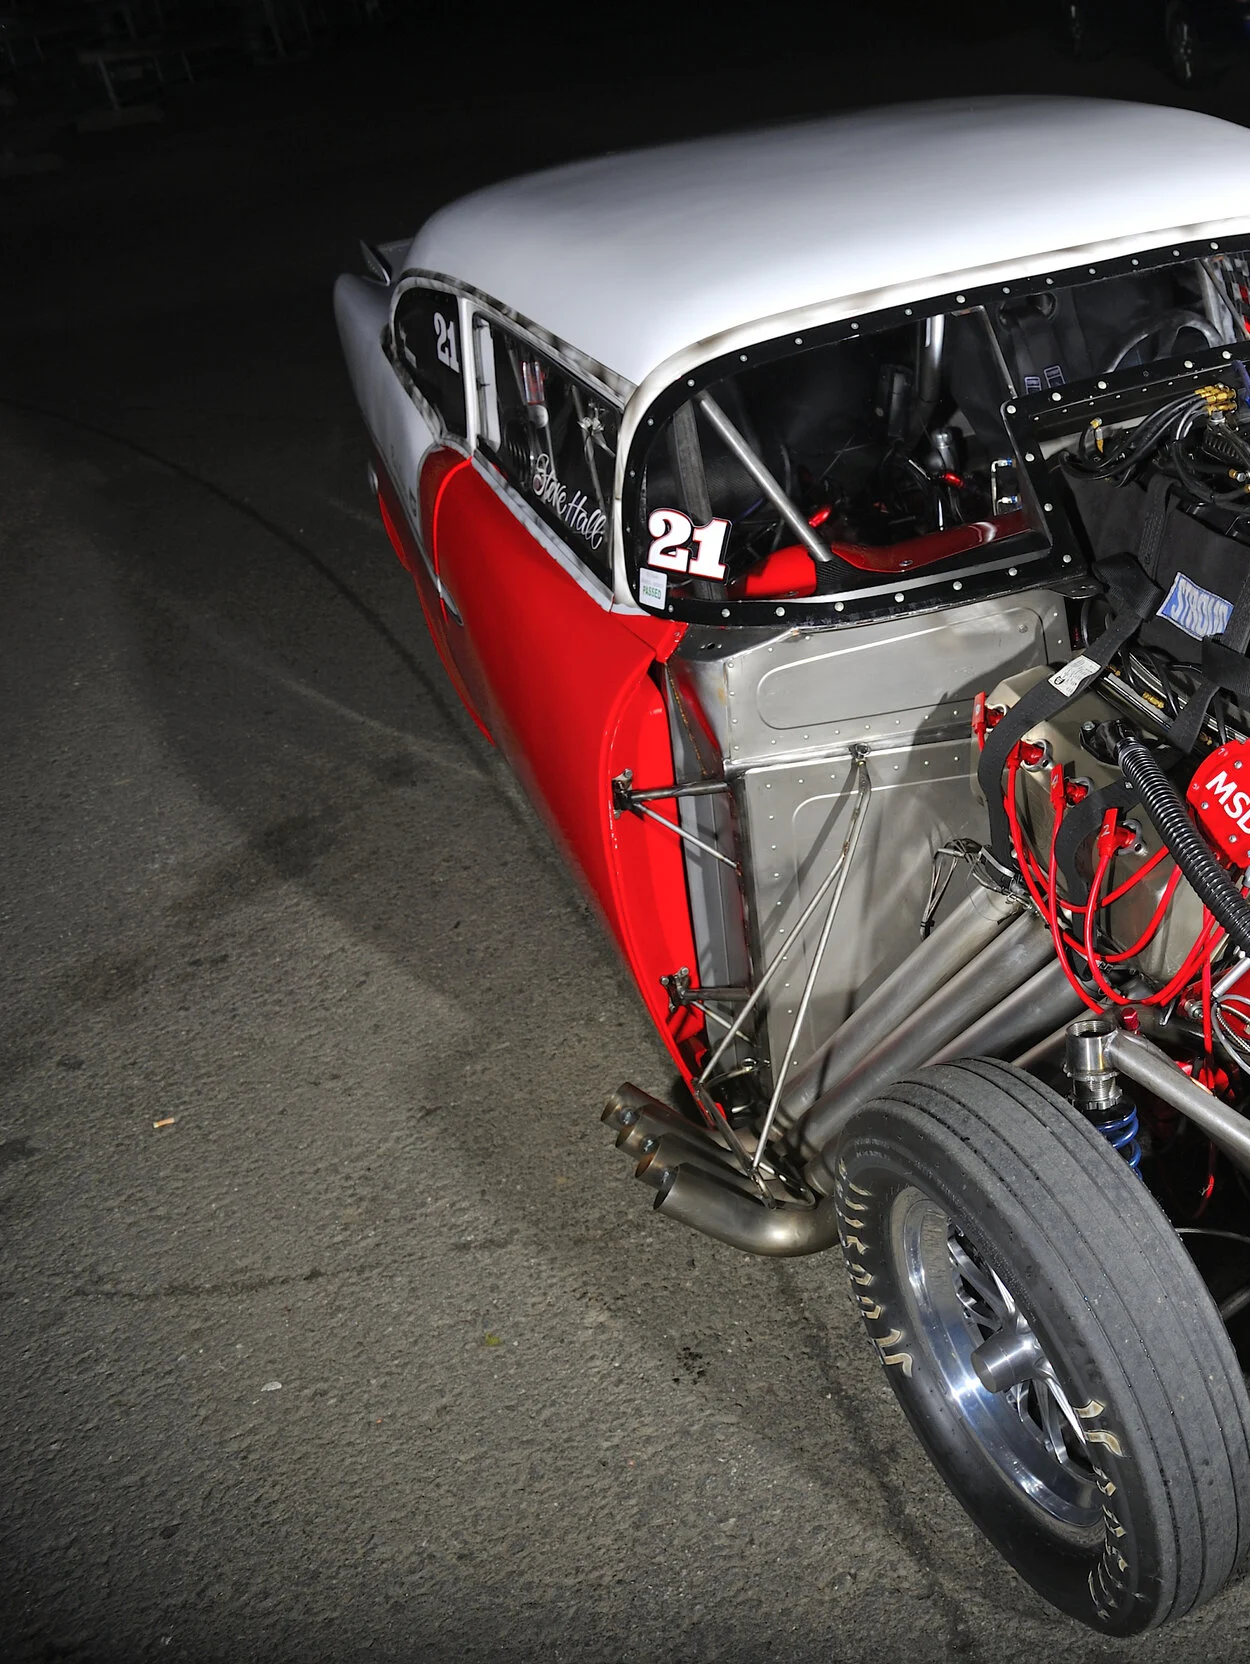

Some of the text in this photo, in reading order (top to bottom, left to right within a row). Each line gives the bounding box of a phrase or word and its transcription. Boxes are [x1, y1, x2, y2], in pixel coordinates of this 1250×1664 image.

[433, 312, 460, 373] 21
[565, 490, 607, 550] Hall
[648, 508, 730, 582] 21
